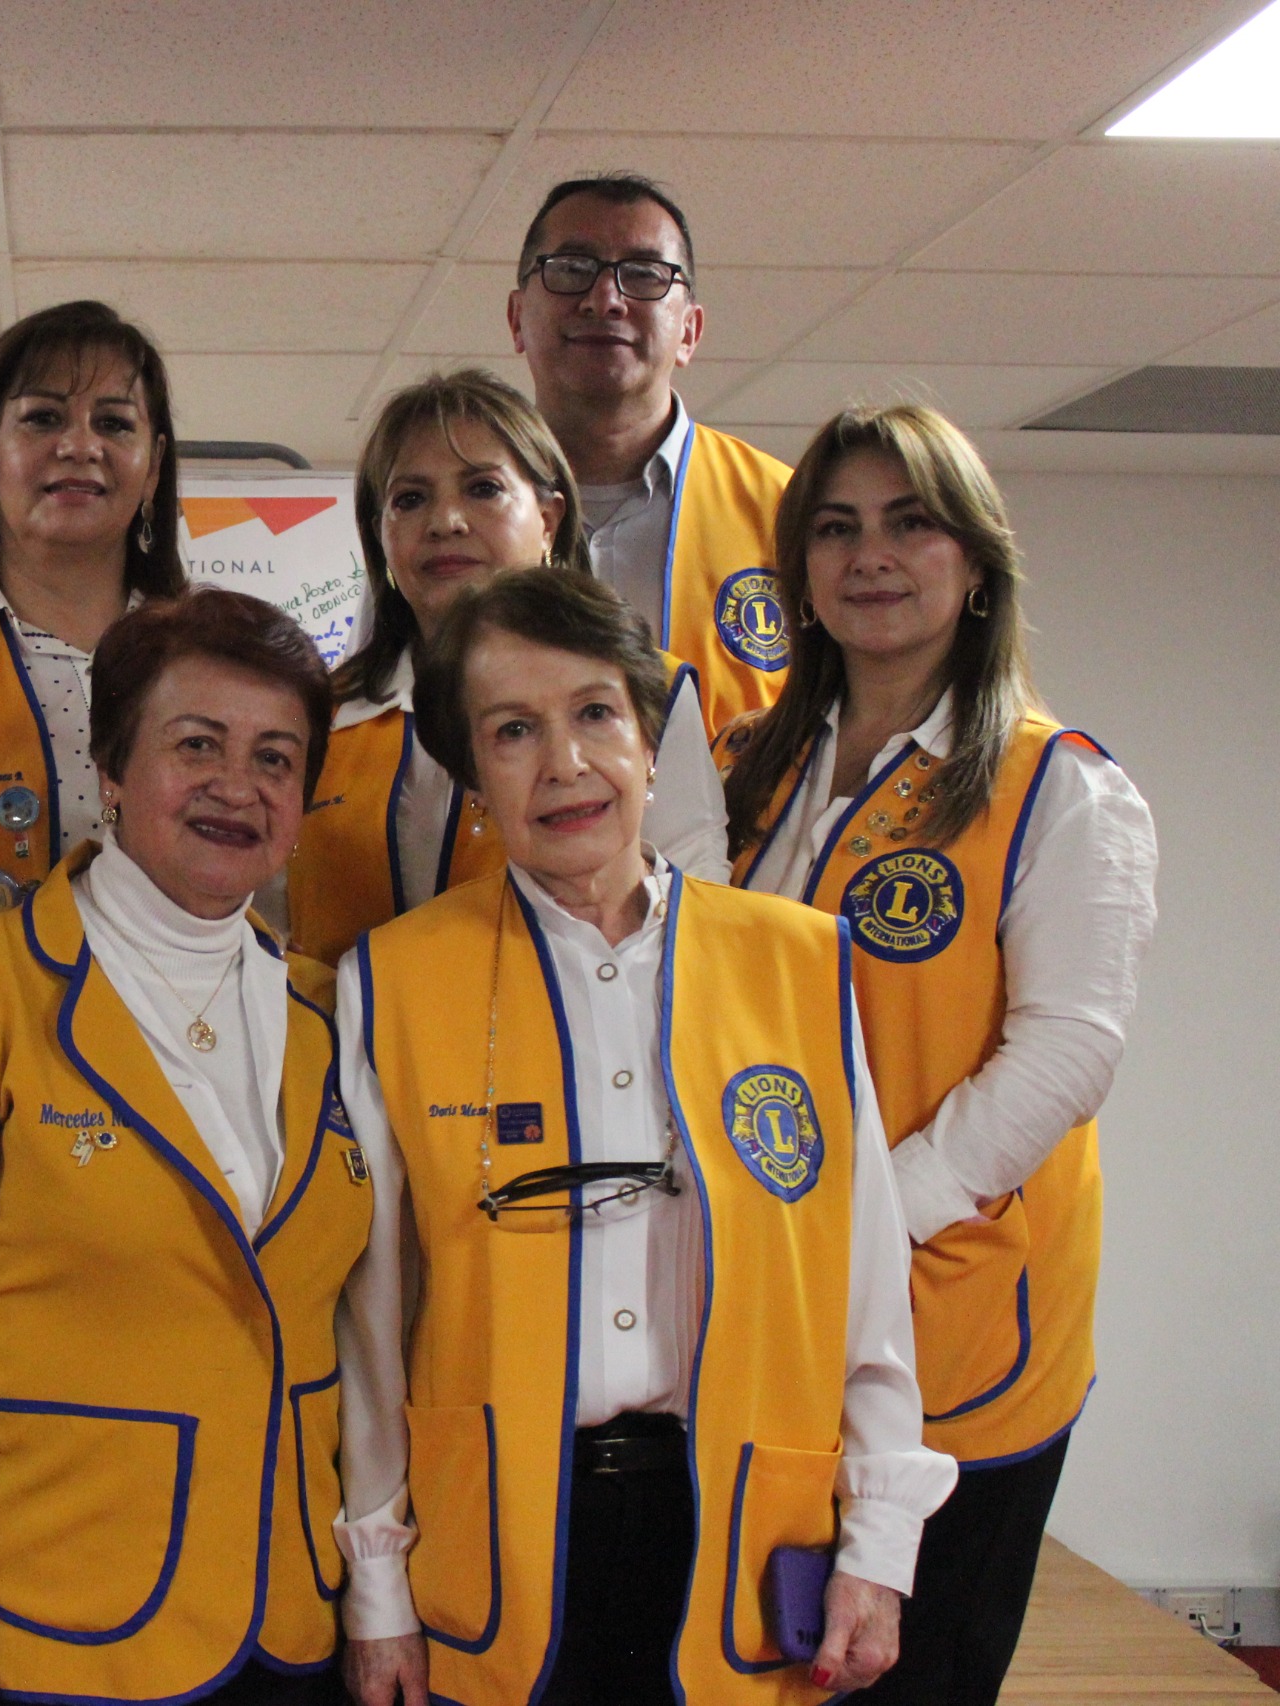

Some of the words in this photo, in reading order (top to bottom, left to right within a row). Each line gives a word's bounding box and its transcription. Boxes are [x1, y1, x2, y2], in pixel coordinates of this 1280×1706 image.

[187, 560, 275, 574] TIONAL
[734, 577, 779, 596] LION
[751, 602, 776, 635] L
[883, 856, 943, 880] LIONS
[885, 881, 918, 923] L
[864, 922, 928, 946] INTERNATIONAL
[742, 1077, 798, 1101] LIONS
[39, 1103, 105, 1128] Mercedes
[429, 1104, 457, 1117] Doris
[764, 1109, 794, 1153] L
